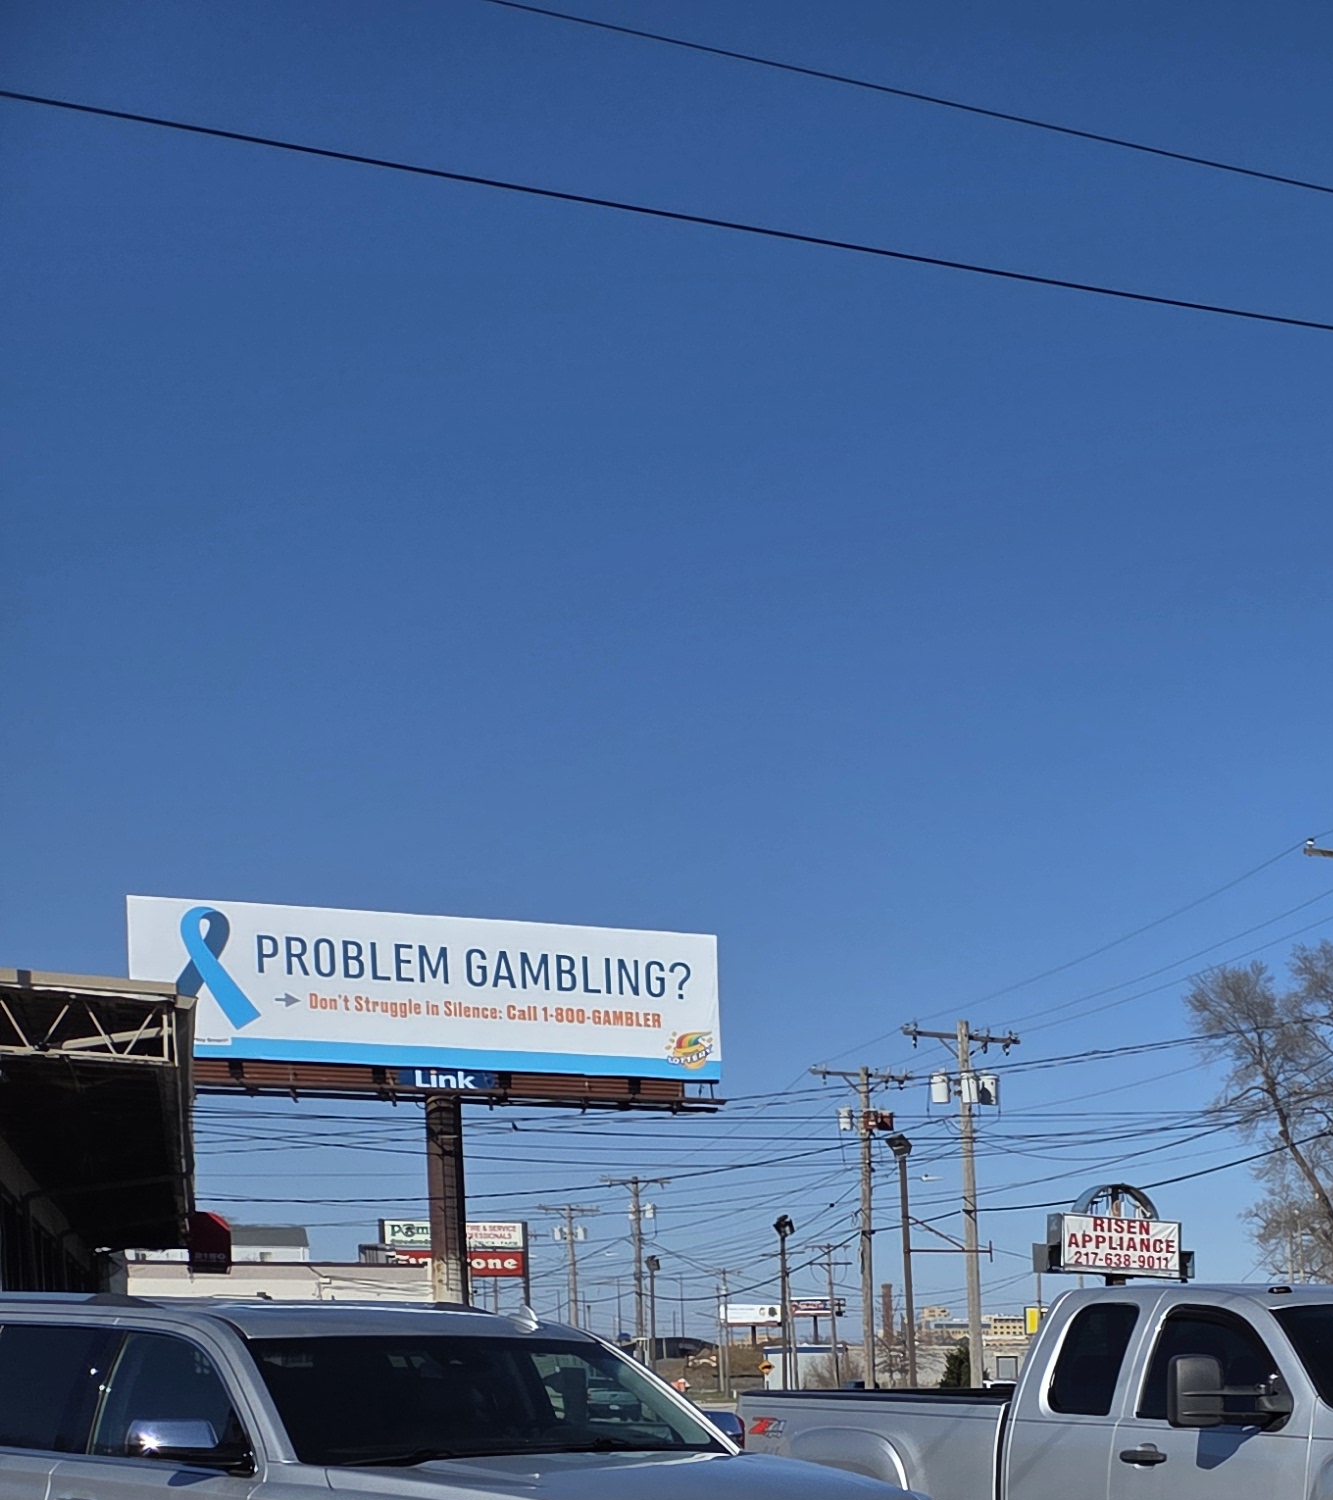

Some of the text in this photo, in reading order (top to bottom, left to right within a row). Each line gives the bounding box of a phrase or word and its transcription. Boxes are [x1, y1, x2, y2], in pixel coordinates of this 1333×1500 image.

[256, 934, 691, 999] PROBLEM GAMBLING?
[309, 992, 661, 1028] Don't Struggle in Silence: Call 1-800-GAMBLER
[415, 1069, 478, 1089] Link
[1093, 1217, 1150, 1235] RISEN
[1067, 1233, 1176, 1254] APPLIANCE
[1074, 1251, 1169, 1269] 217-638-9011
